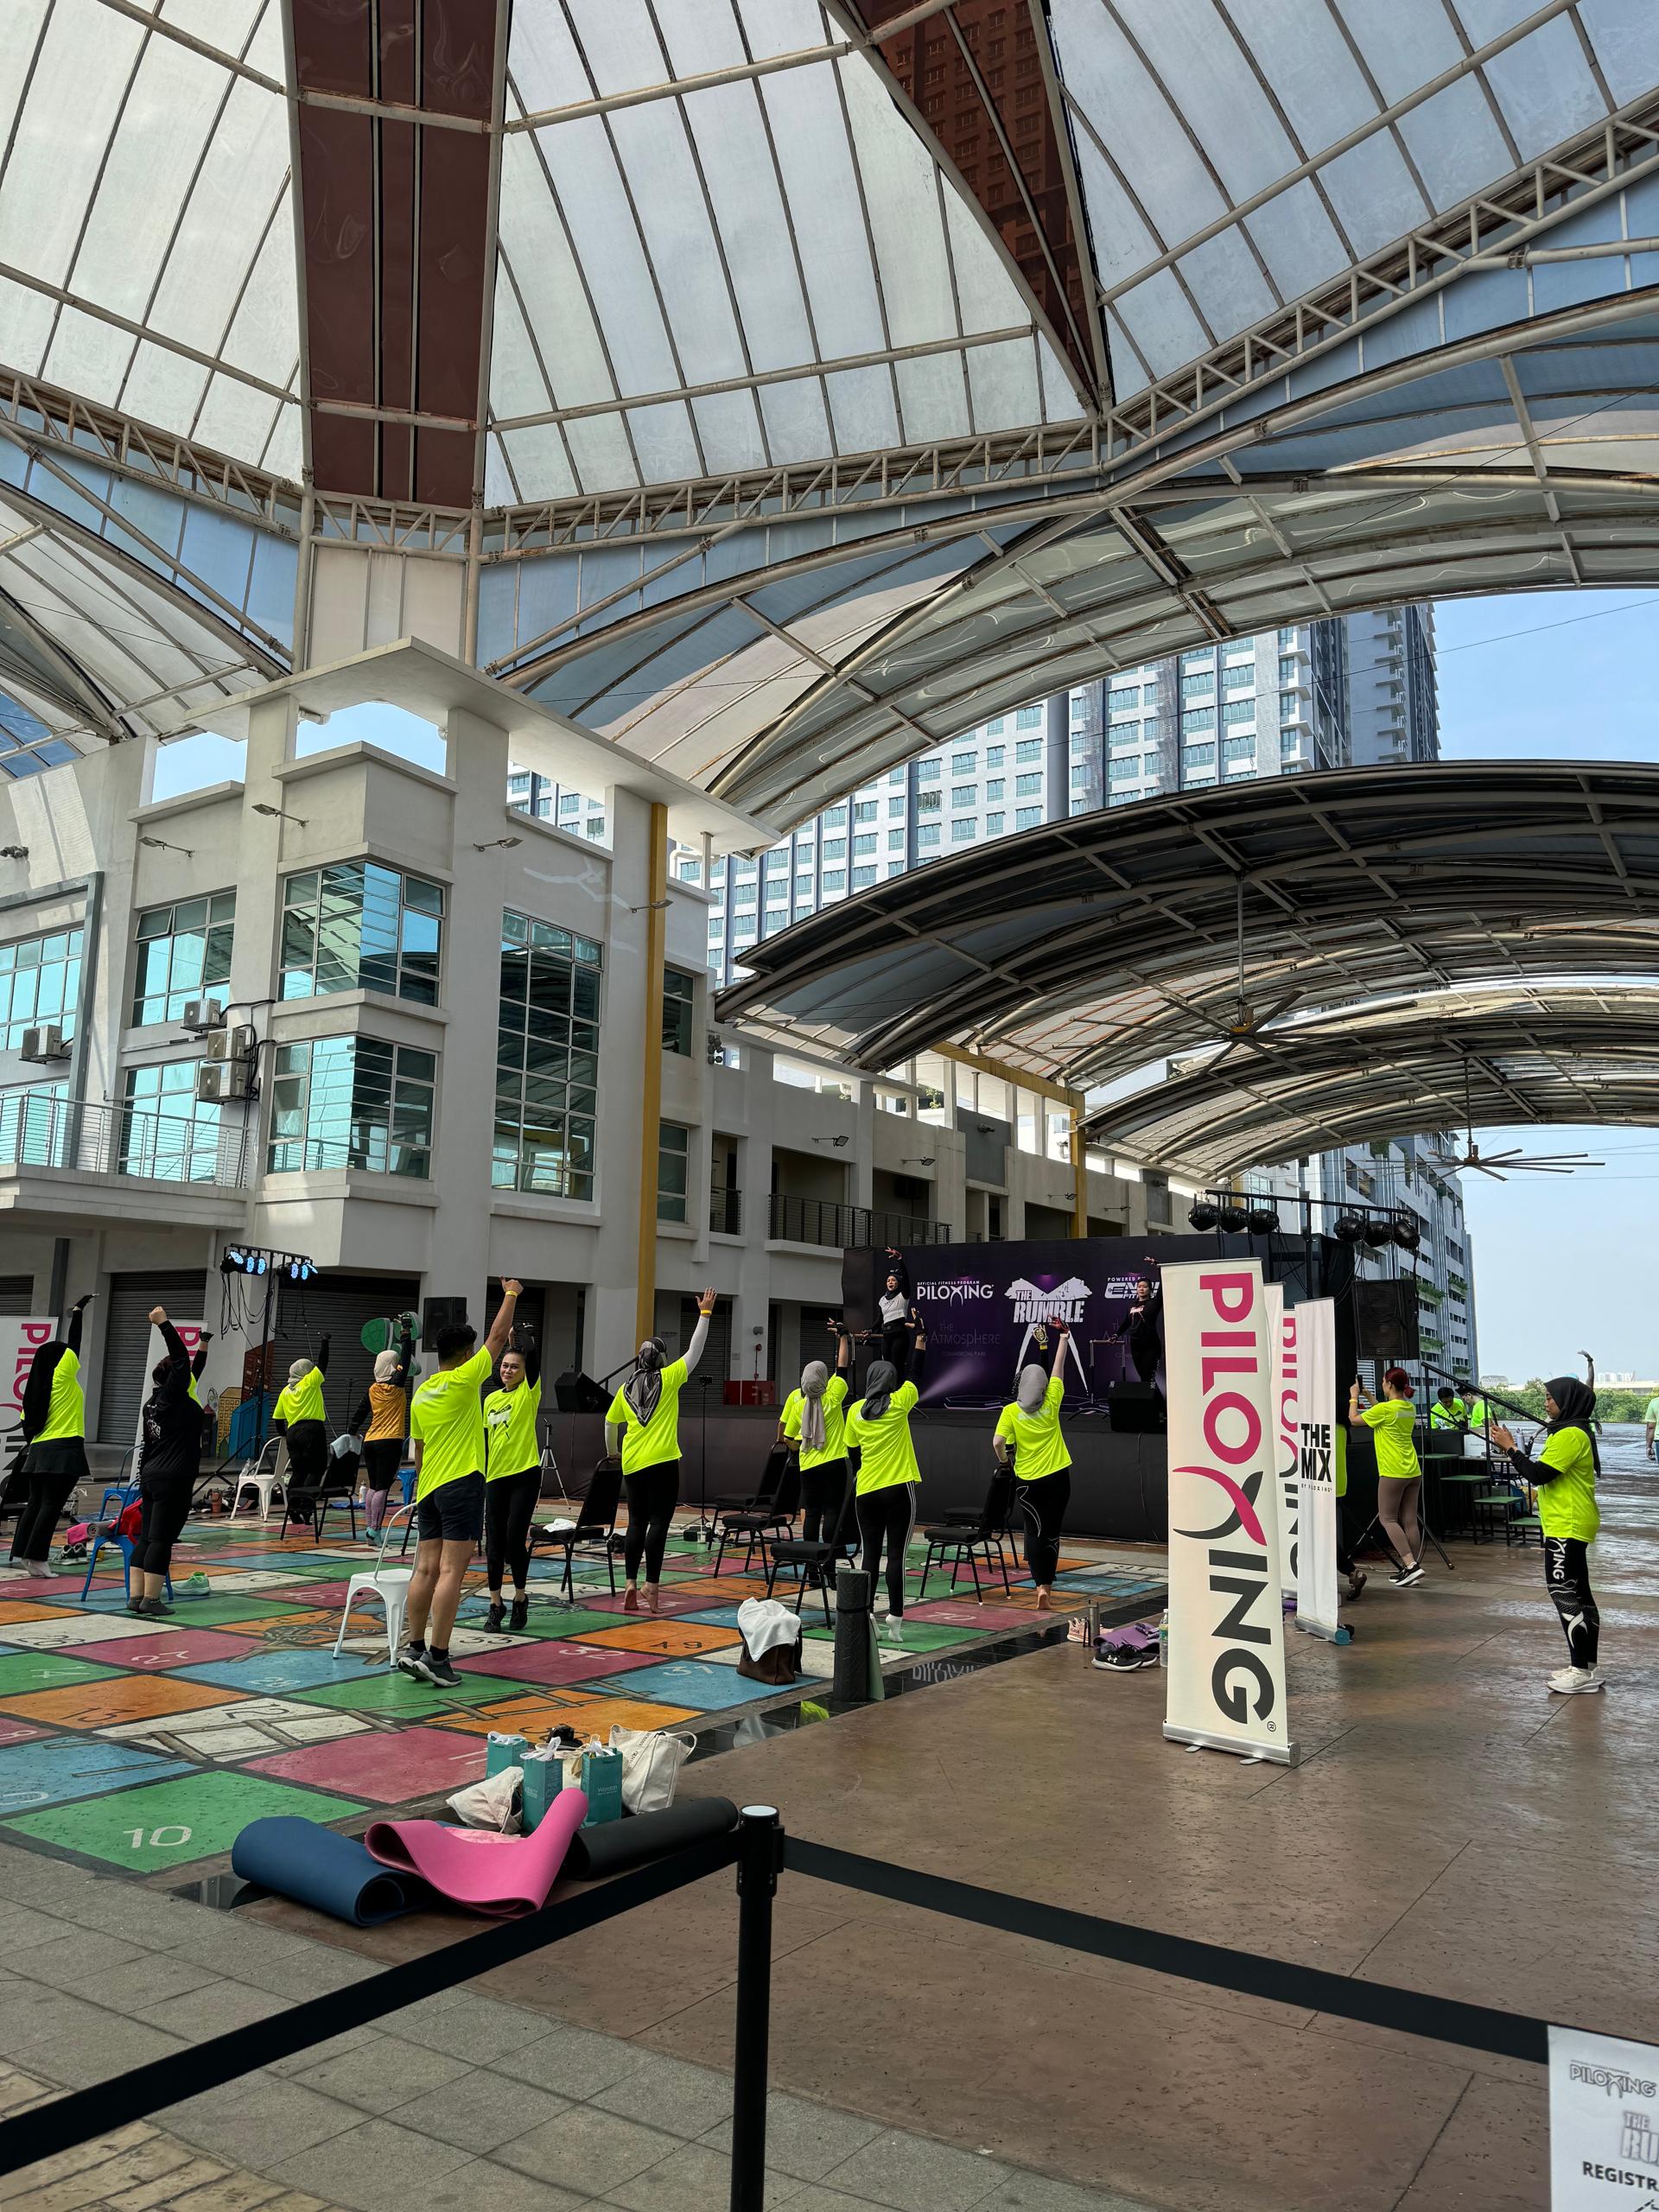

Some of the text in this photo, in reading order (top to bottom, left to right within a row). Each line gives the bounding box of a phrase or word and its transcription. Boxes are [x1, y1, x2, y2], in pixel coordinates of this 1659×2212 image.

[1015, 1290, 1033, 1300] THE
[1013, 1300, 1085, 1323] RUMBLE
[1300, 1423, 1331, 1449] THE
[1300, 1447, 1332, 1483] MIX
[649, 1641, 703, 1649] 49
[658, 1666, 715, 1676] 31
[123, 1825, 193, 1849] 10
[1569, 2063, 1657, 2099] PILOXING
[1624, 2110, 1650, 2130] THE
